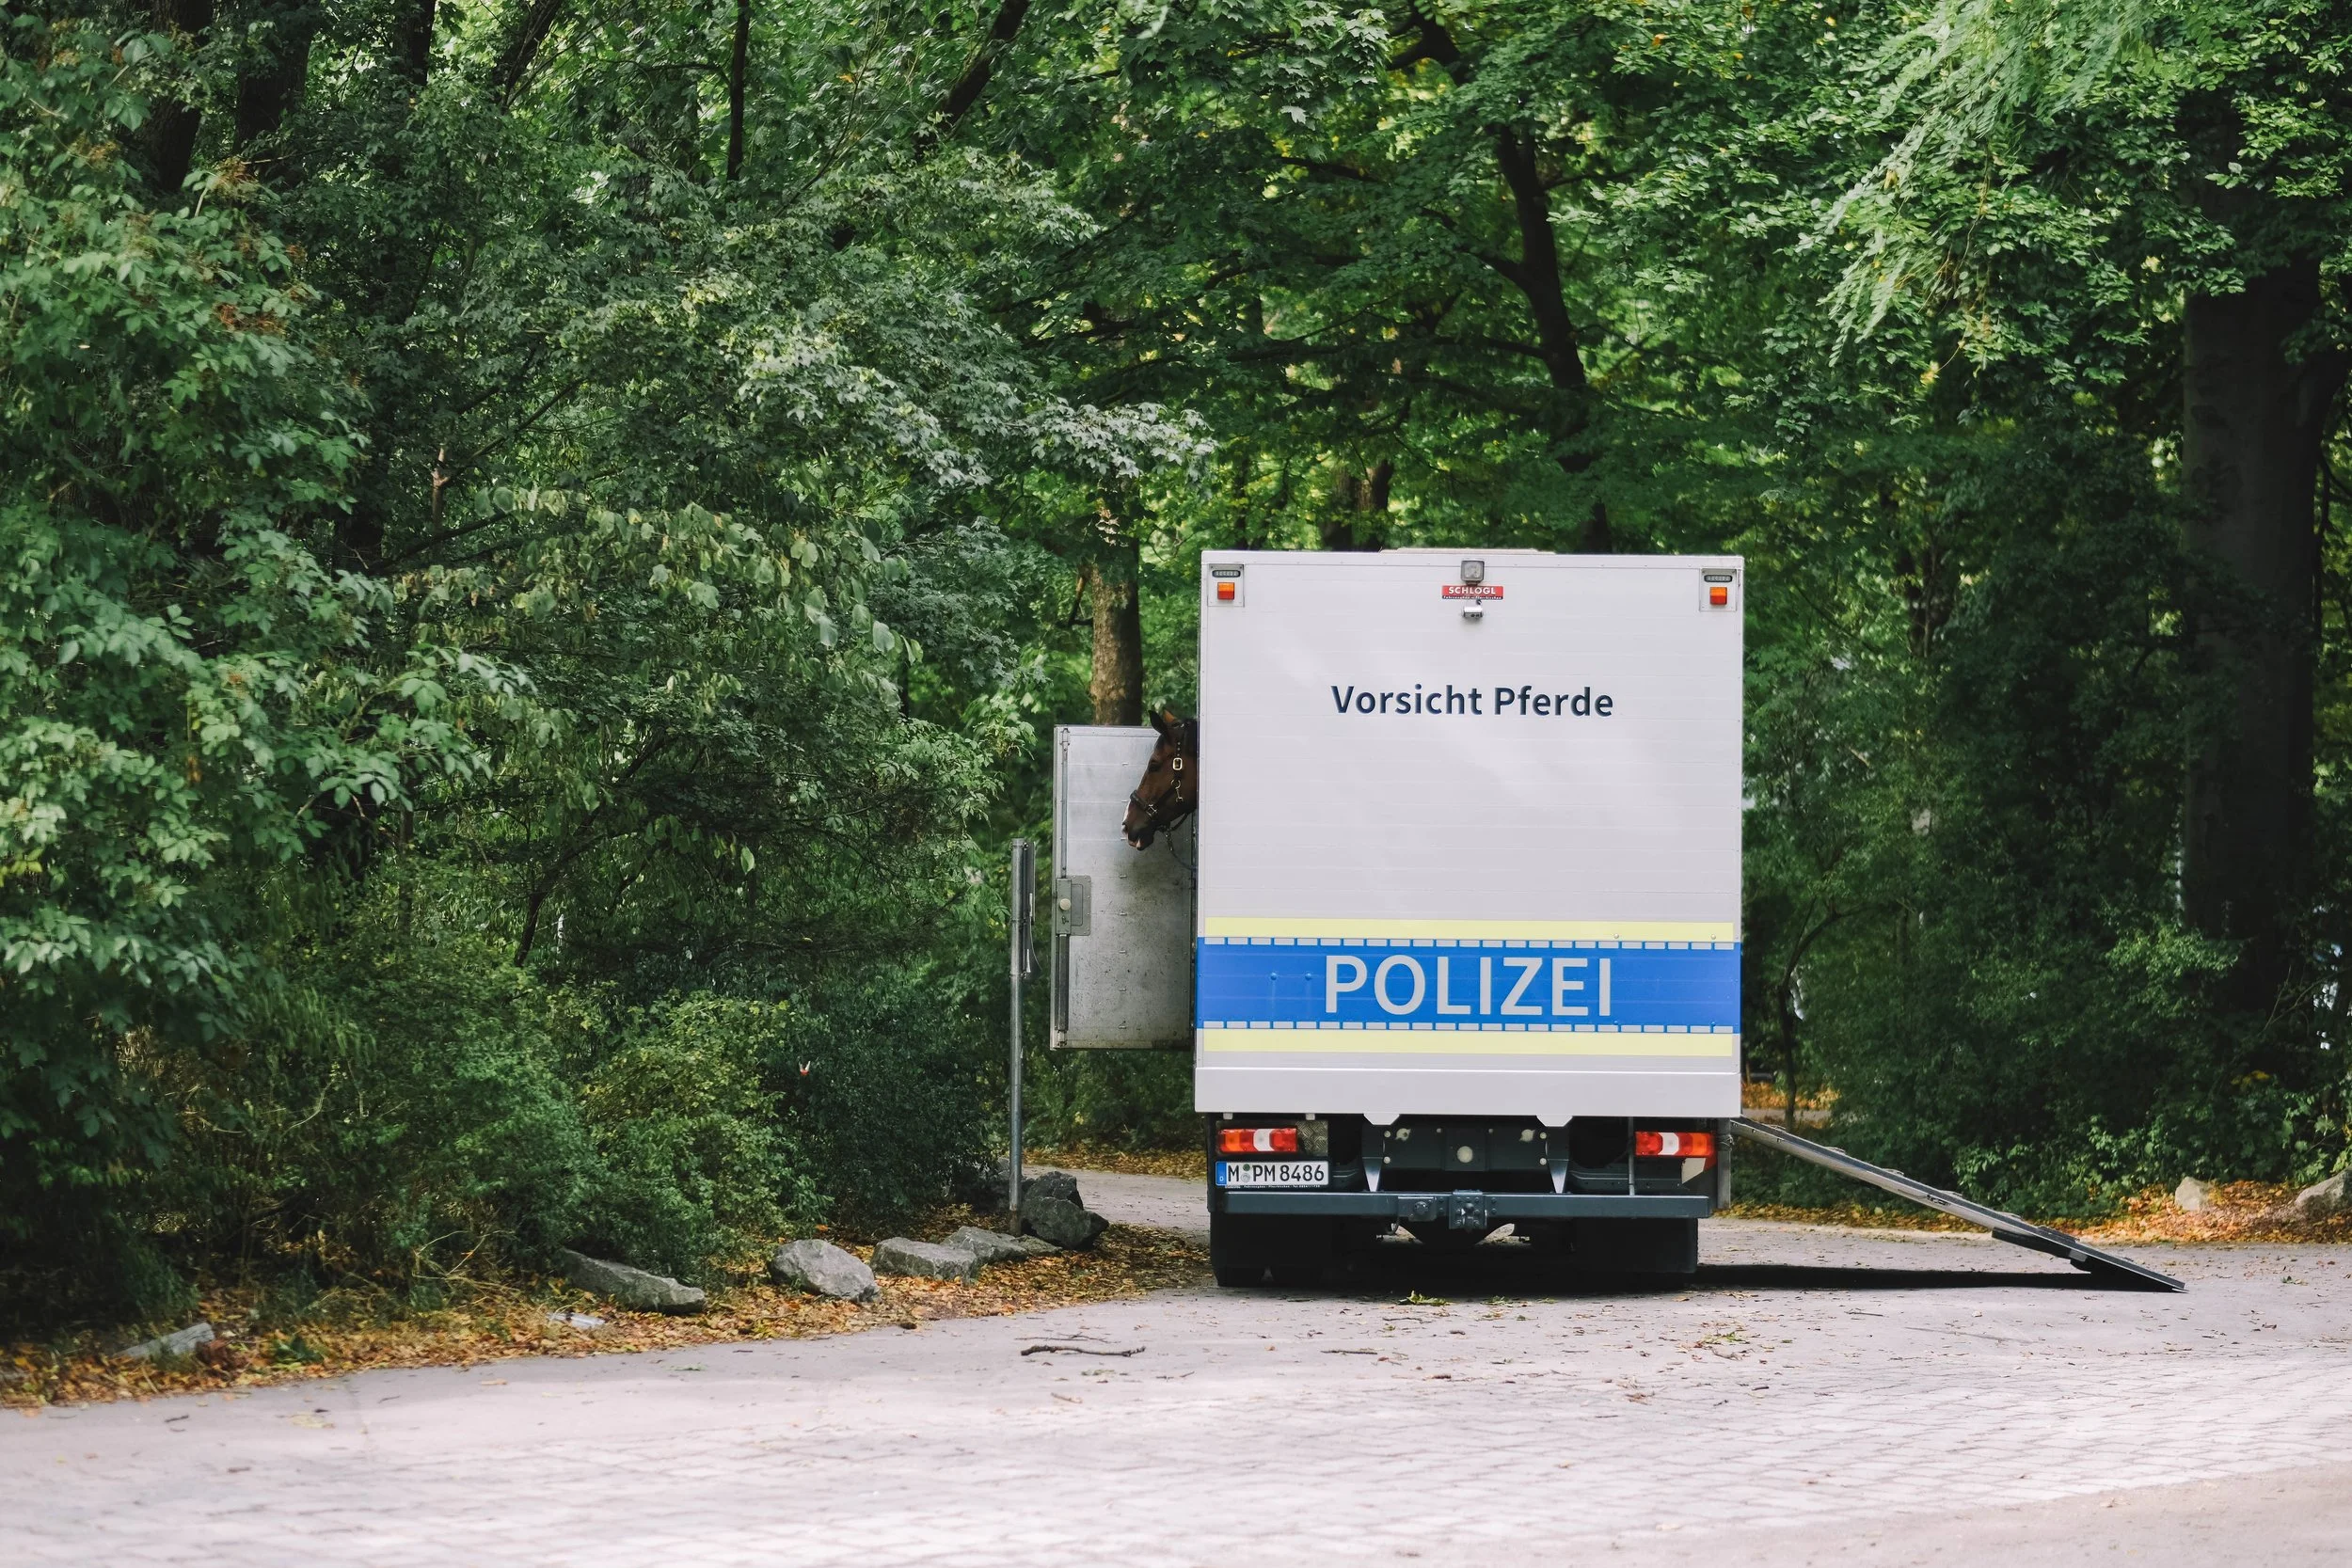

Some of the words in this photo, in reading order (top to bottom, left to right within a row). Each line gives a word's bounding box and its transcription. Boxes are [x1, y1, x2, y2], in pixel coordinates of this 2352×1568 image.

[1331, 684, 1483, 716] Vorsicht
[1494, 686, 1614, 718] Pferde
[1325, 954, 1611, 1017] POLIZEI
[1228, 1164, 1240, 1182] M
[1252, 1164, 1276, 1182] PM
[1279, 1164, 1325, 1182] 8486
